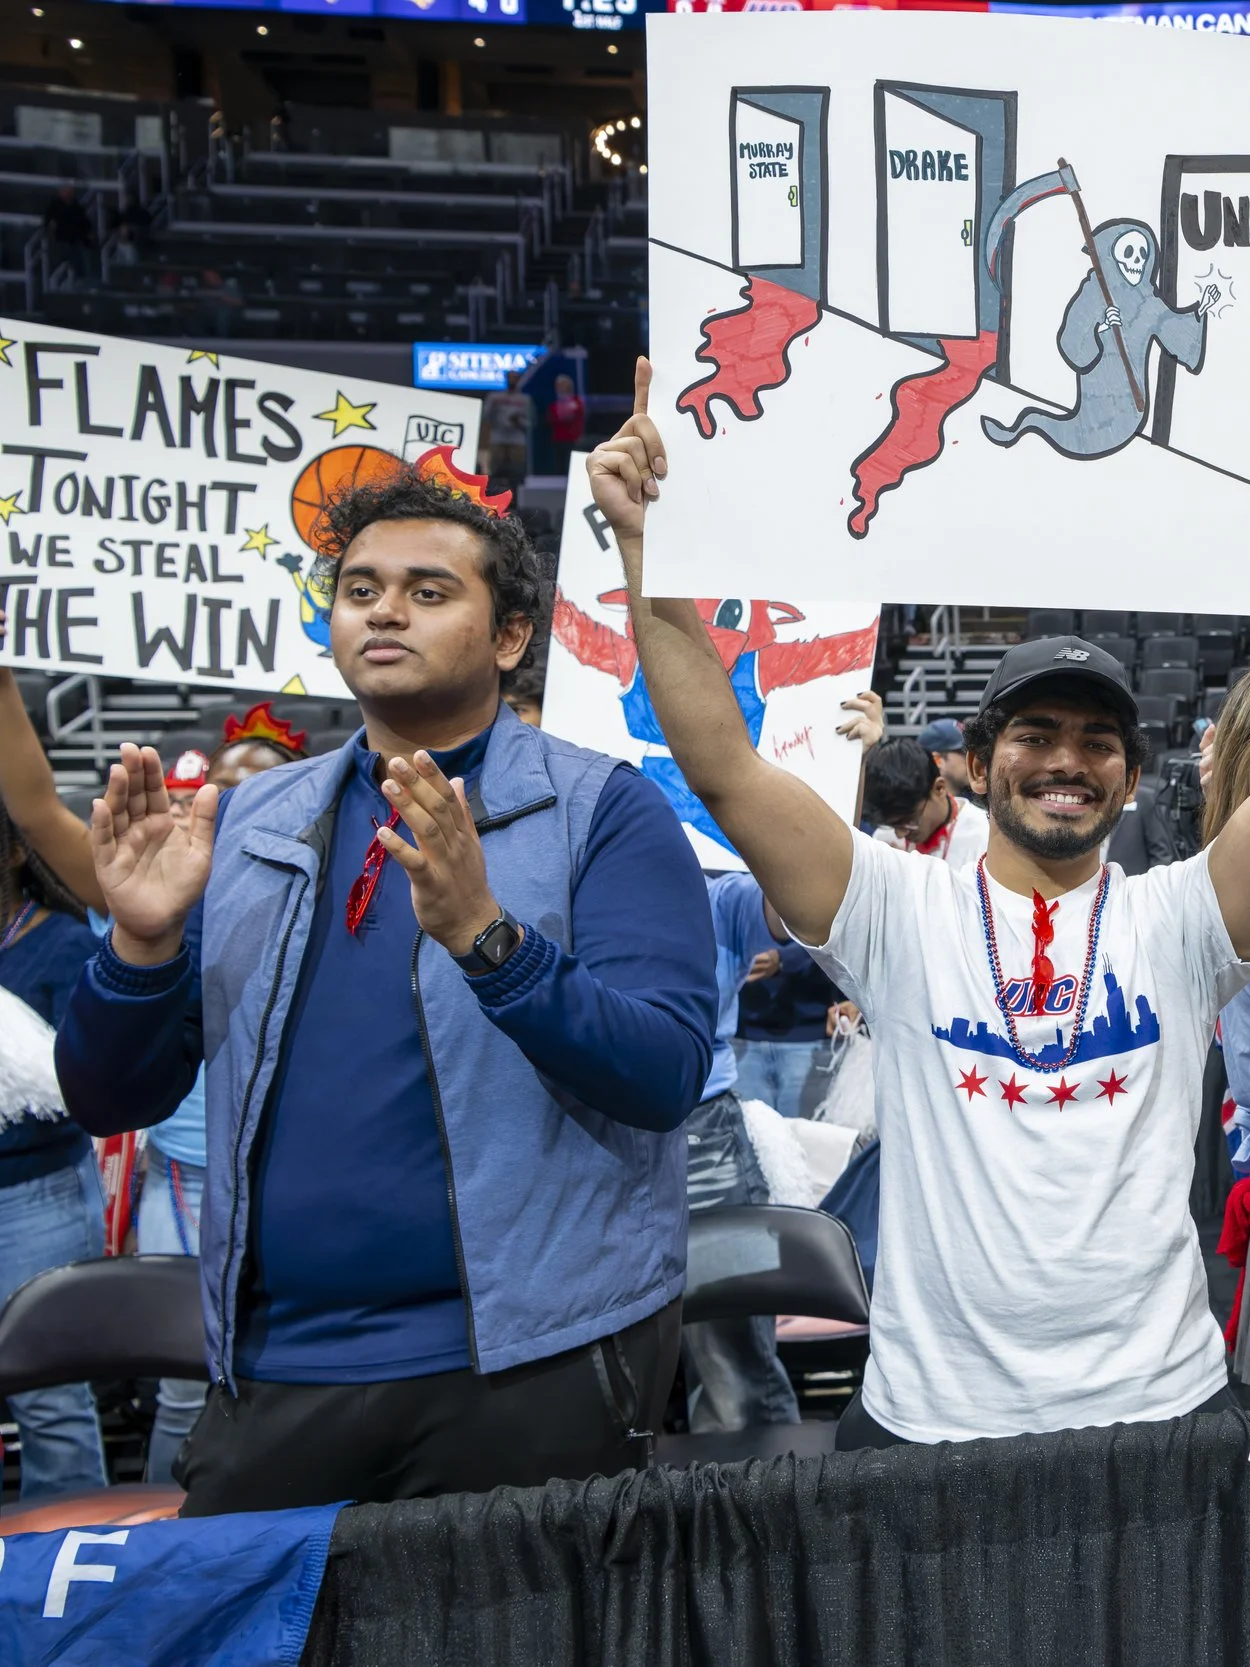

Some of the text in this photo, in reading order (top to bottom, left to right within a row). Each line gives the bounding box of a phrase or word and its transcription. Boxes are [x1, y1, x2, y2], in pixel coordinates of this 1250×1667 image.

[740, 142, 793, 160] MURRAY
[749, 162, 789, 179] STATE
[889, 149, 969, 182] DRAKE
[24, 341, 302, 465] FLAMES
[416, 422, 454, 444] UIC
[1, 444, 257, 535] TONIGHT
[9, 531, 244, 583] WE STEAL
[0, 575, 281, 679] THE WIN
[995, 974, 1079, 1017] UC
[0, 1530, 130, 1617] F
